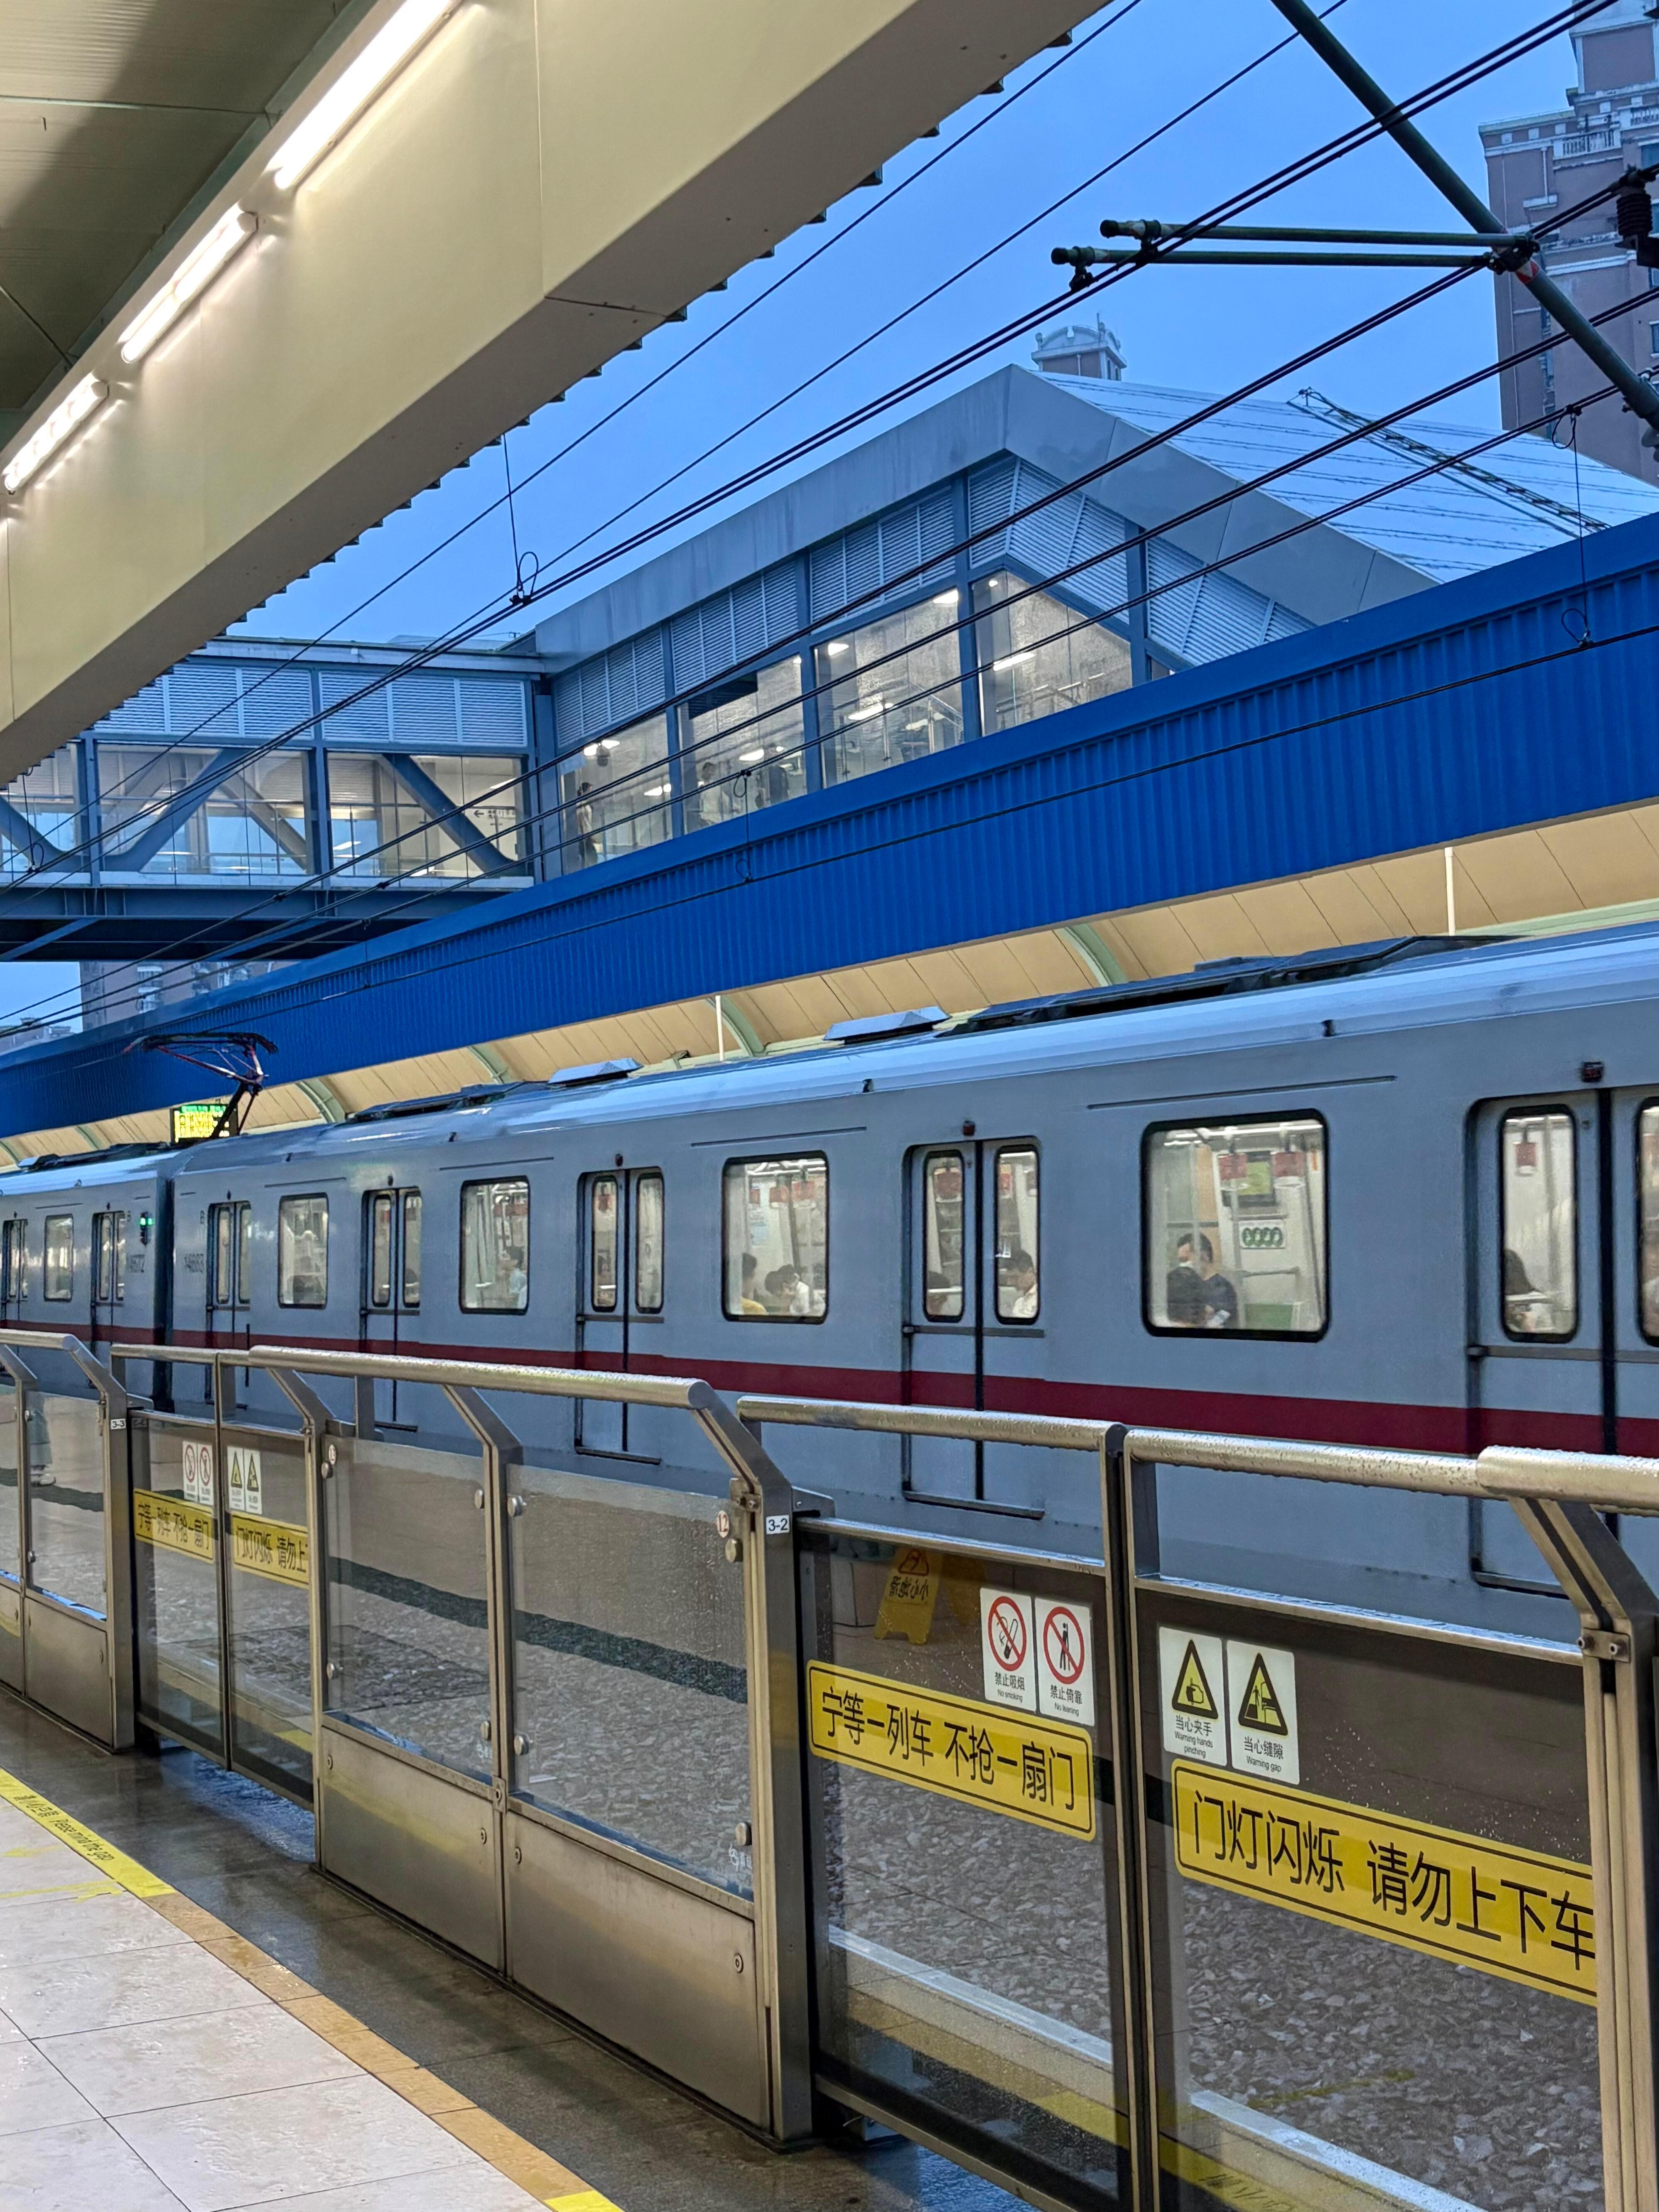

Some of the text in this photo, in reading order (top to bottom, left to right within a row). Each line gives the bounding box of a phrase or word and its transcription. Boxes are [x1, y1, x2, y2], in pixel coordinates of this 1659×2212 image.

[113, 1420, 125, 1428] 3-3
[768, 1518, 788, 1531] 3-2
[277, 1535, 308, 1573] 请勿上
[995, 1672, 1025, 1691] 禁止吸烟
[1005, 1691, 1023, 1702] smoking
[1050, 1684, 1082, 1704] 禁止倚靠
[1055, 1702, 1079, 1717] No leaning
[1176, 1715, 1212, 1736] 当心夹手
[822, 1686, 1075, 1810] 宁等一列车 不抢一扇门
[1175, 1731, 1213, 1748] Warning hands
[1244, 1736, 1284, 1760] 当心缝隙
[1184, 1746, 1206, 1758] pinching
[1247, 1755, 1281, 1773] Warning gap
[1194, 1790, 1595, 1970] 门灯闪烁 请勿上下车
